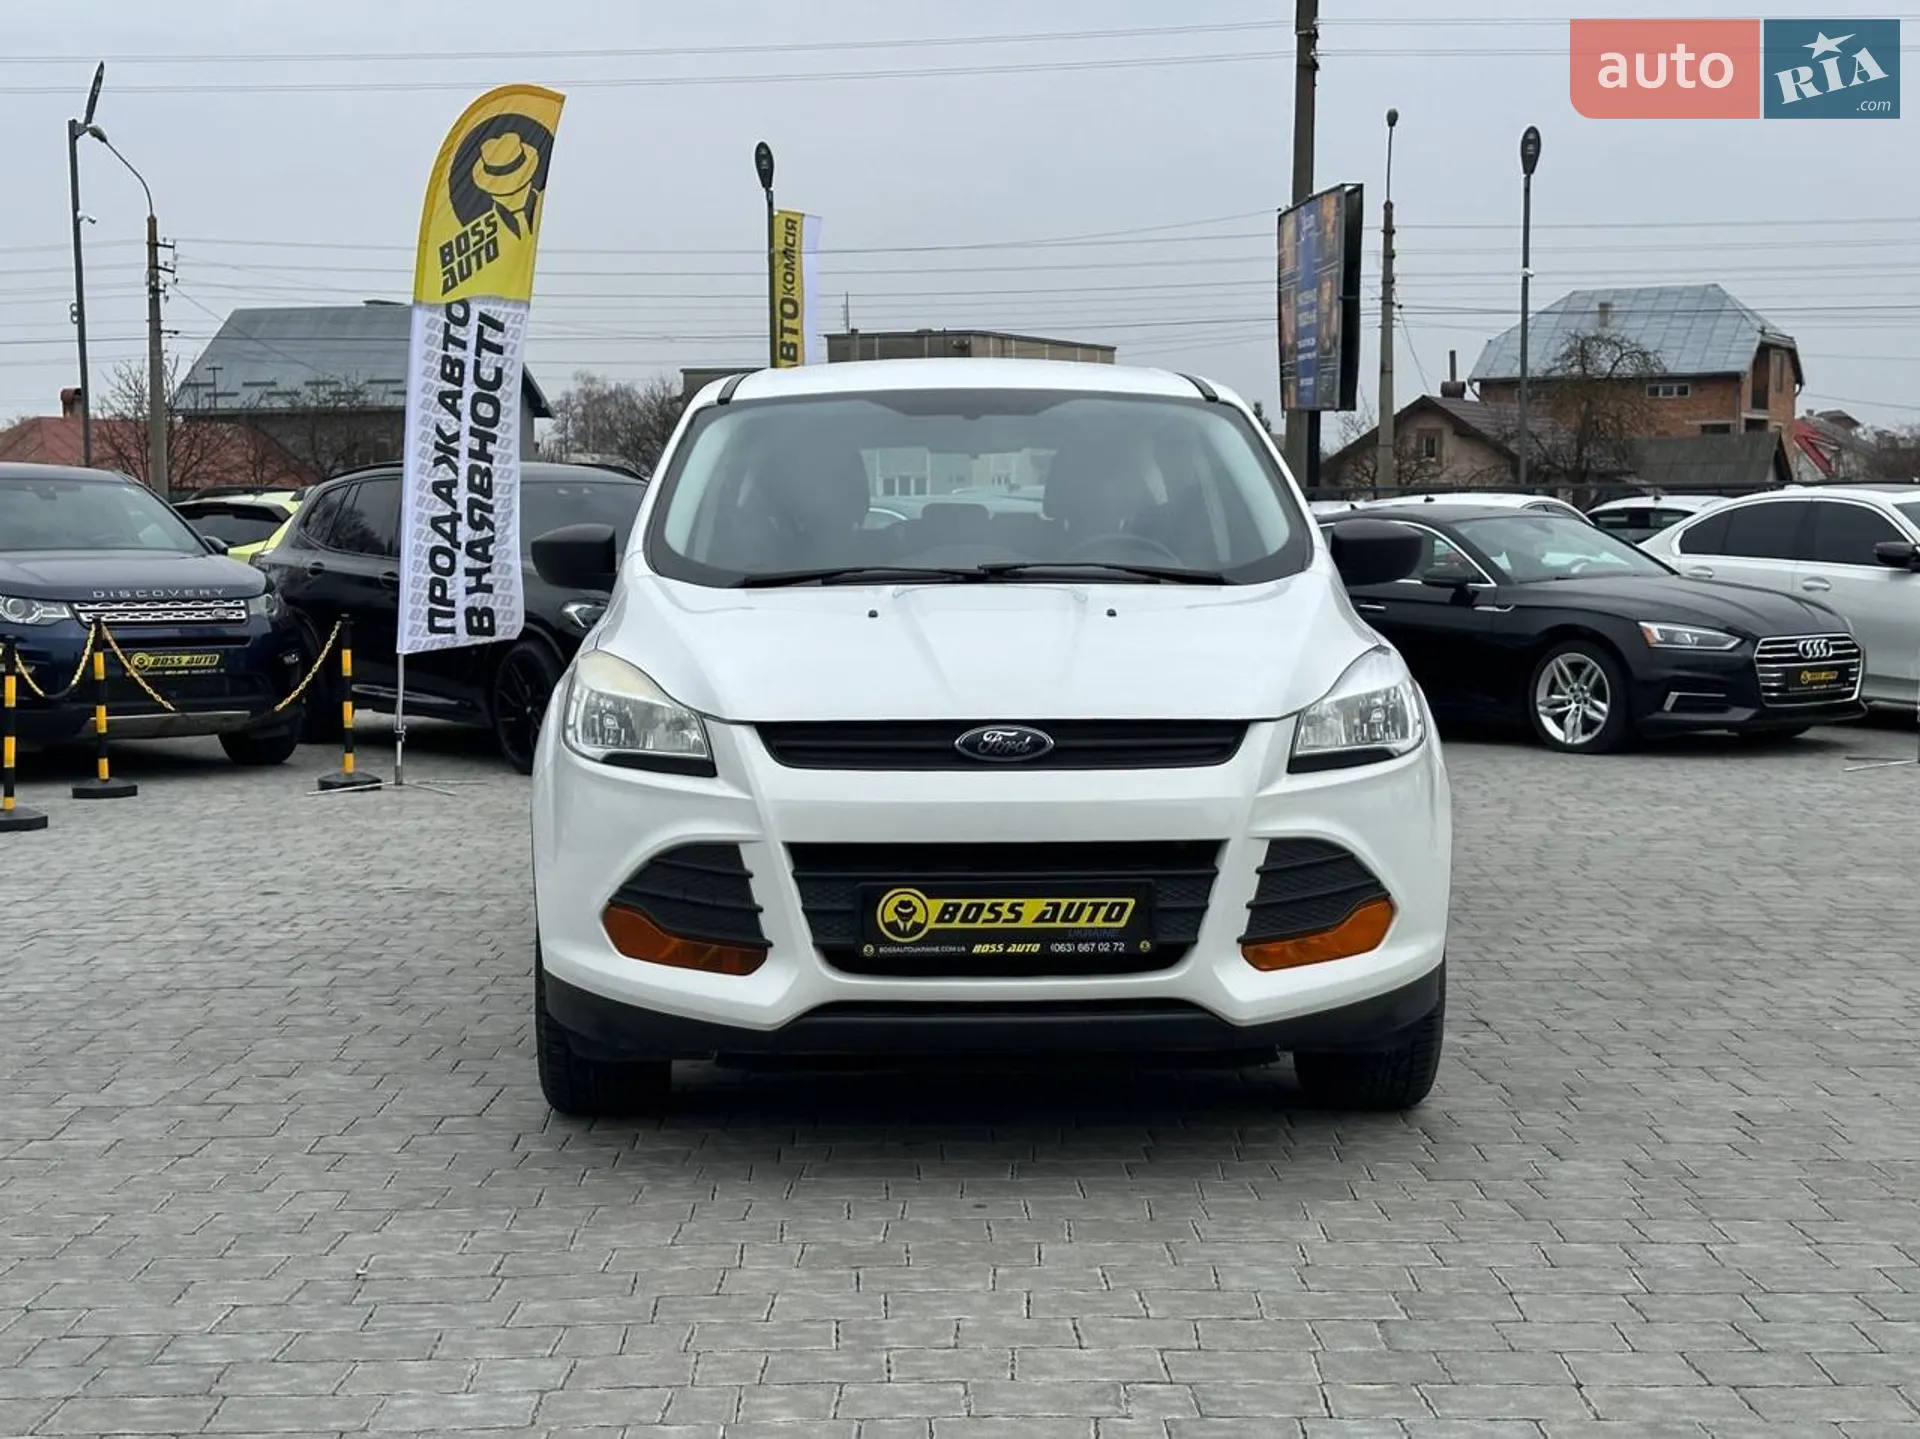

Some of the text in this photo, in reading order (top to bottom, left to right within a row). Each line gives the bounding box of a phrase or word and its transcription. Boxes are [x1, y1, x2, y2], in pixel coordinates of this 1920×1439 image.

[439, 213, 498, 266] BOSS
[441, 236, 499, 296] AUTO
[780, 218, 799, 366] ВТОКОМІСІЯ
[438, 300, 470, 422] АВТО
[464, 311, 504, 636] В НАЯВНОСТІ
[428, 422, 462, 634] ПРОДАЖ
[92, 588, 224, 598] DISCOVERY
[151, 655, 217, 665] BOSS AUTO
[978, 730, 1032, 753] Ford
[934, 902, 1127, 924] BOSS AUTO
[971, 943, 1040, 953] BOSS AUTO
[1050, 942, 1125, 953] (063) 667 02 72
